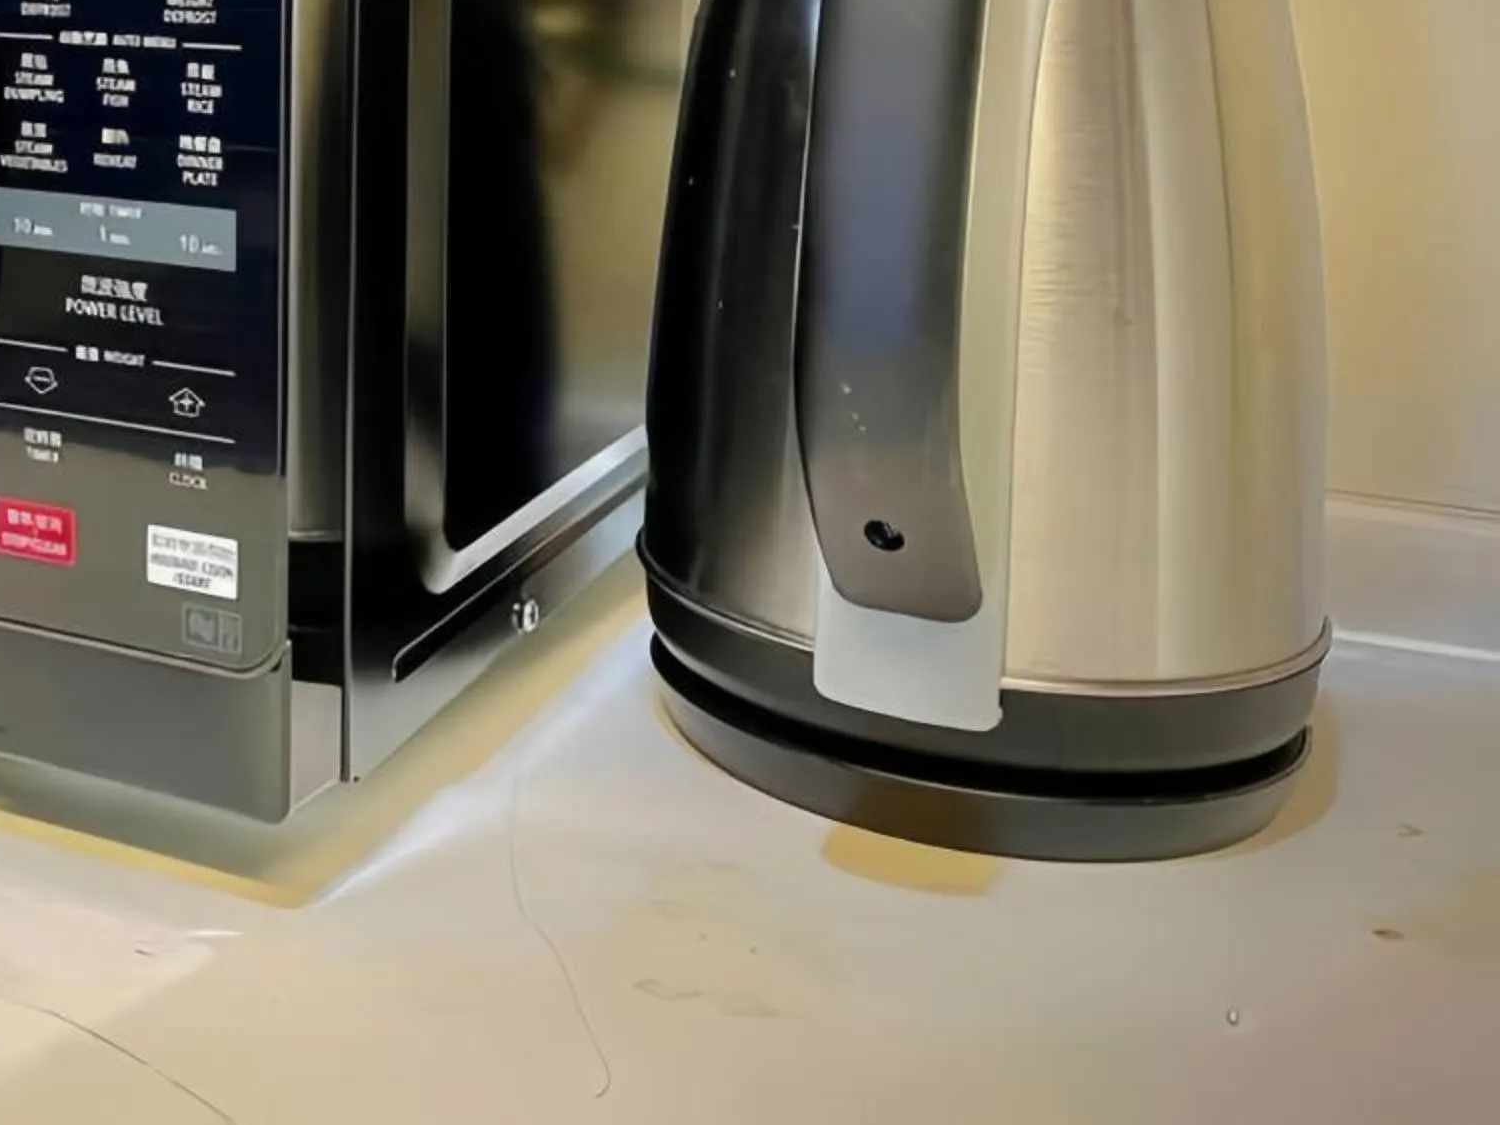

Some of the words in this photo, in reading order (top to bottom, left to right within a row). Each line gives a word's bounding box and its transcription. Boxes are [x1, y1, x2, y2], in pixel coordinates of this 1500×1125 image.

[187, 99, 214, 115] RICE
[182, 171, 218, 187] PLATE
[180, 234, 199, 253] 10
[65, 297, 117, 321] POWER
[119, 304, 164, 326] LEVEL
[103, 349, 146, 367] WEIGHT
[169, 472, 208, 490] CLOCK
